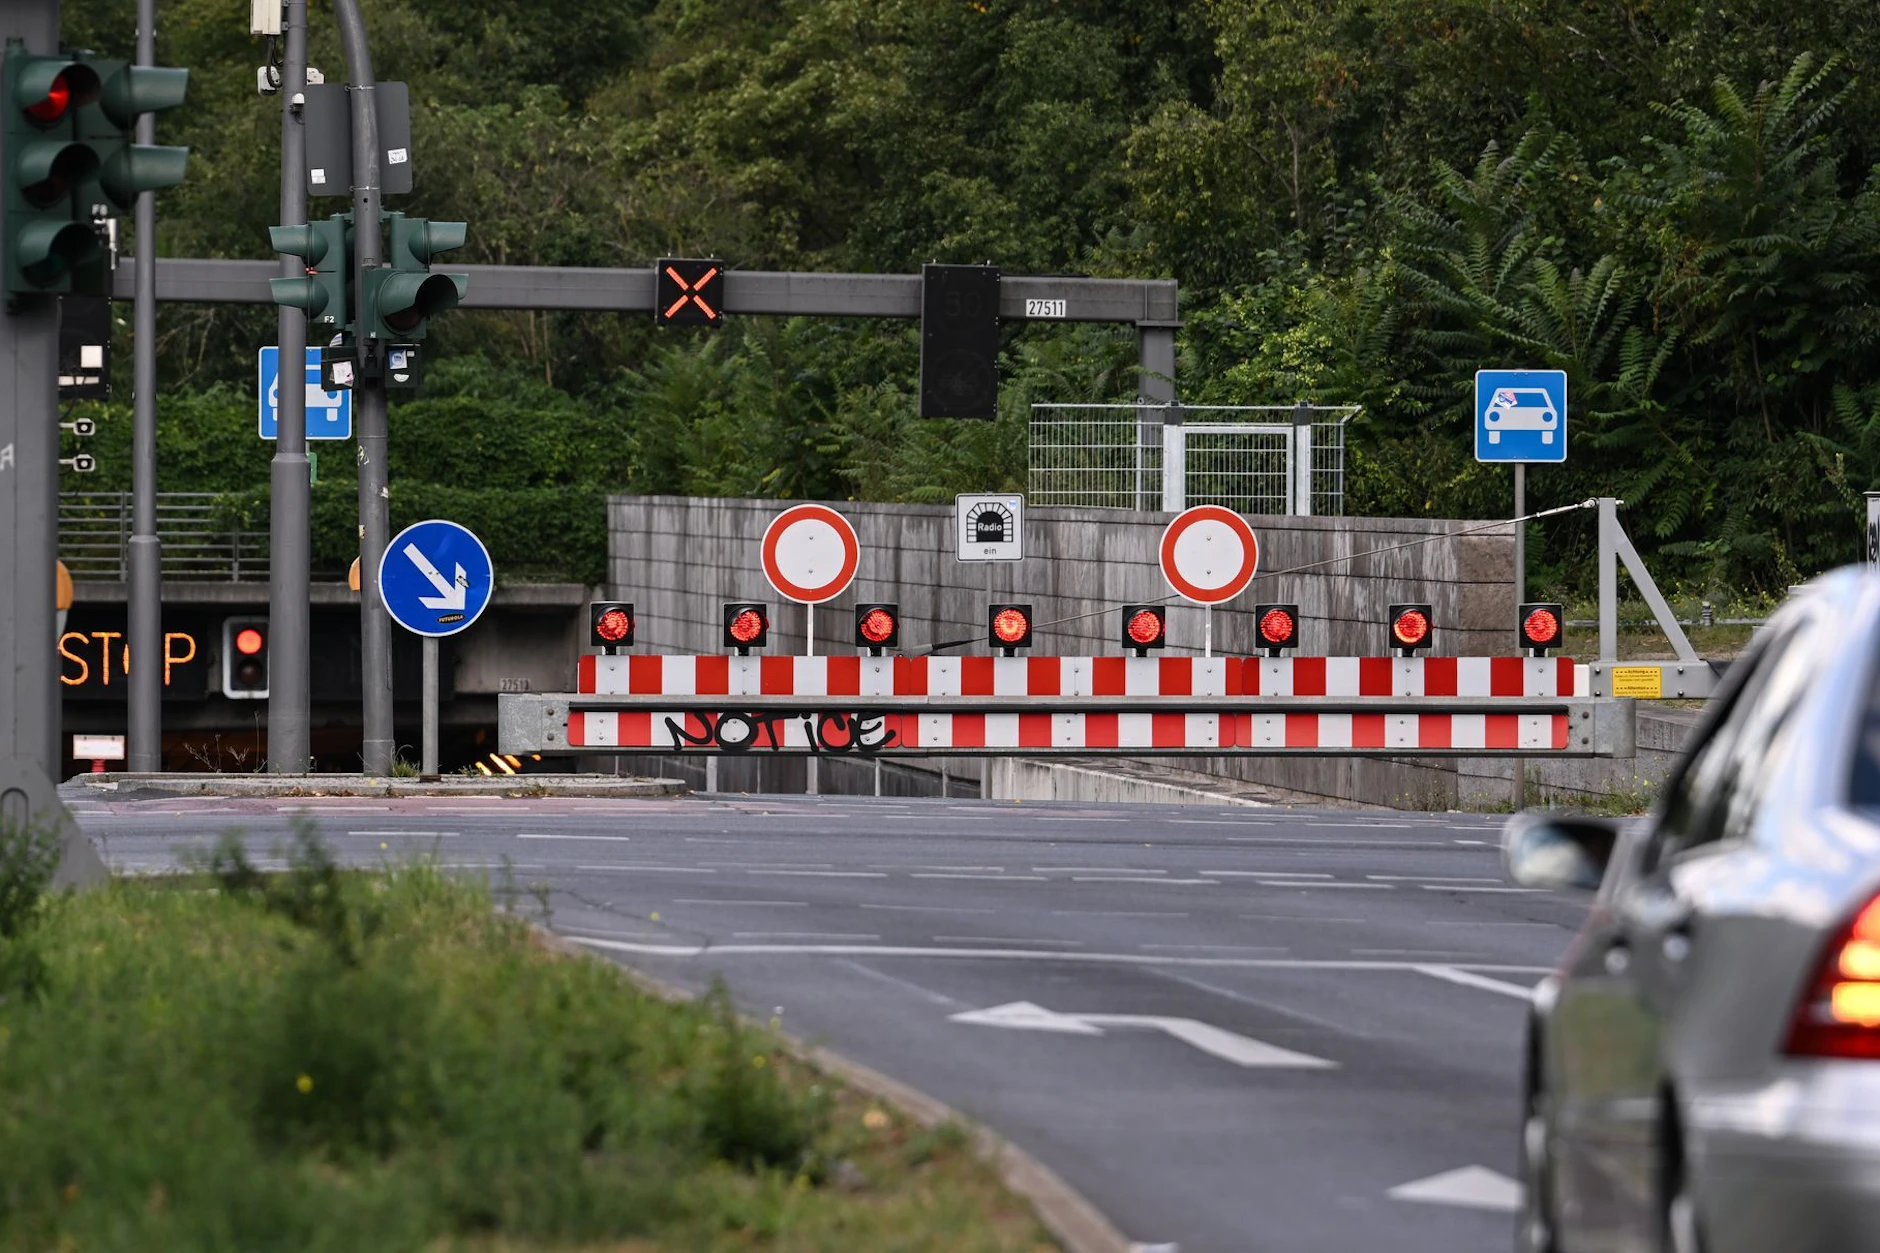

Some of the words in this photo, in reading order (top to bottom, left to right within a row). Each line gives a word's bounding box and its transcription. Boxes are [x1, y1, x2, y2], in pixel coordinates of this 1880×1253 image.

[1028, 300, 1064, 316] 27511
[324, 315, 335, 323] F2
[977, 522, 1003, 532] Radio
[983, 546, 997, 555] ein
[58, 631, 197, 687] STP
